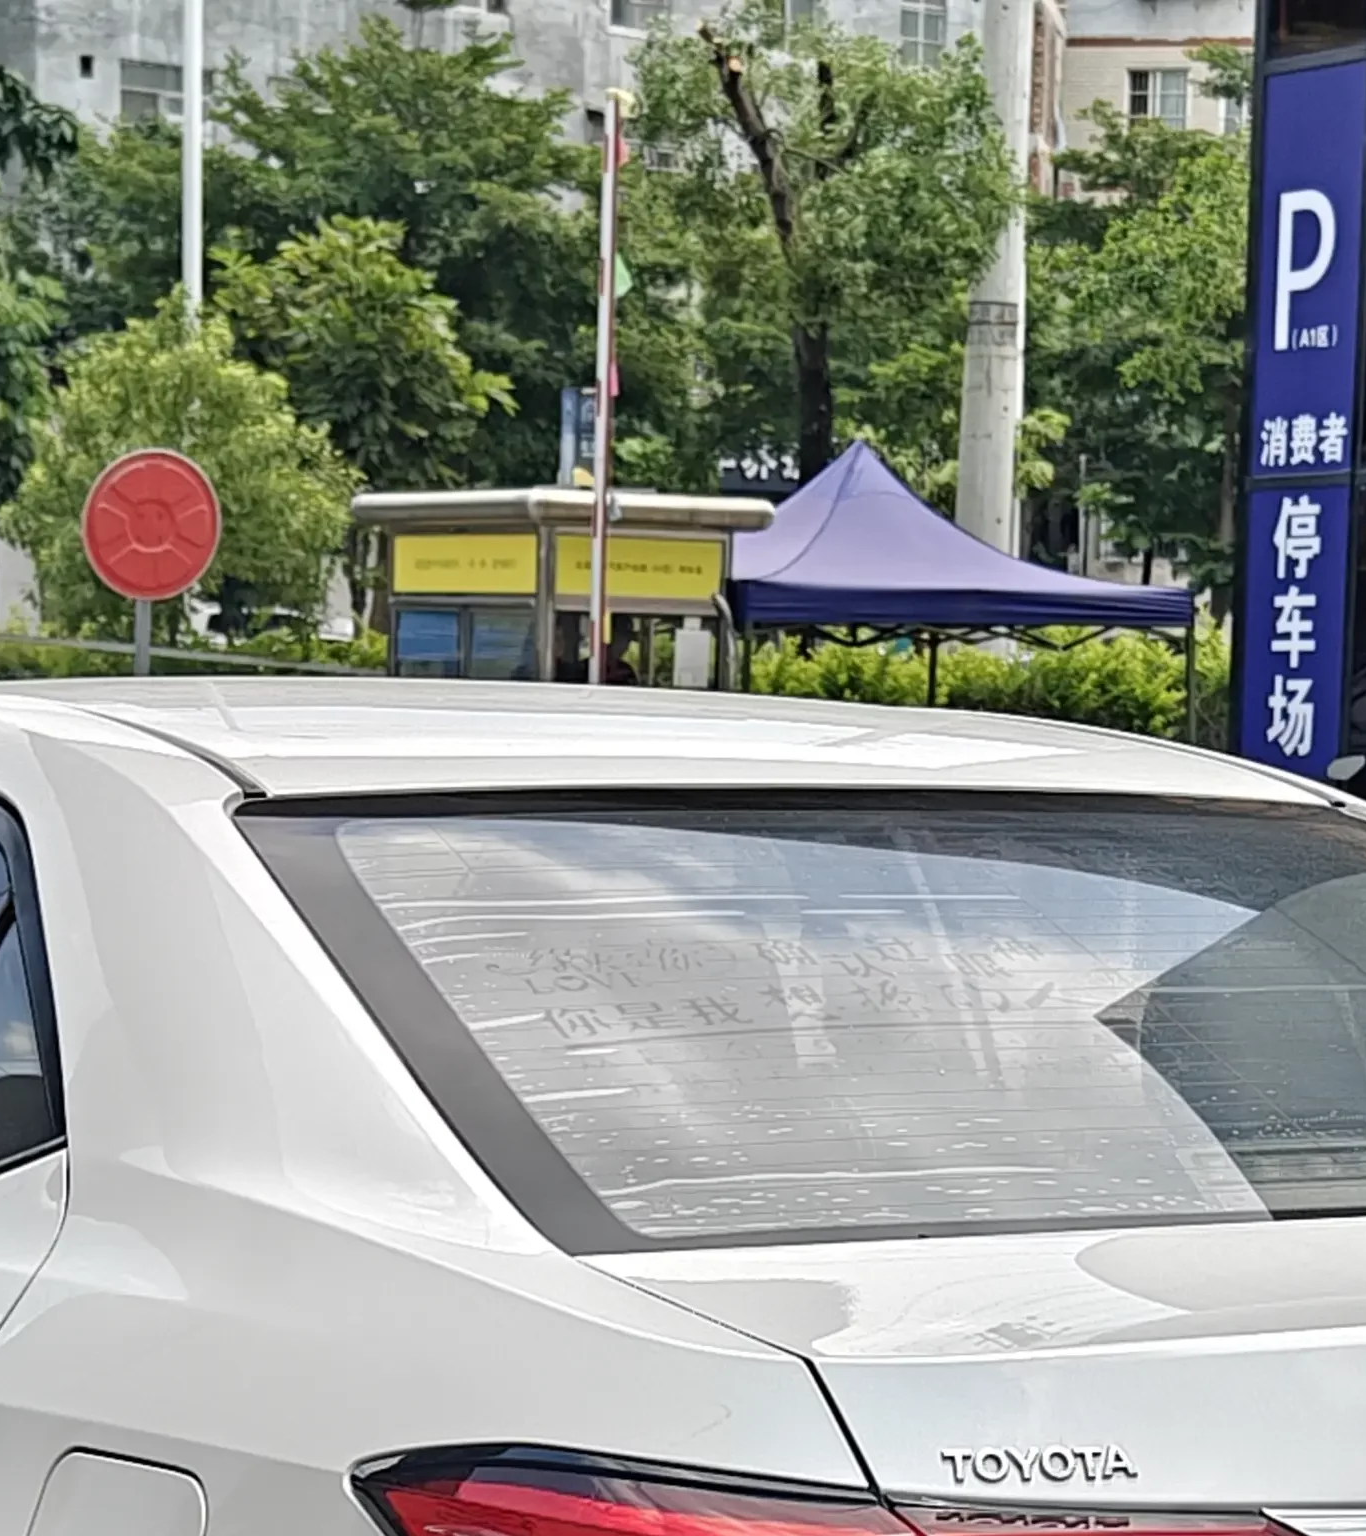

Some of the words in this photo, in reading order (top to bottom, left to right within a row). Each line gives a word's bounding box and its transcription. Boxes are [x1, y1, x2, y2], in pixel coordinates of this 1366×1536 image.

[1274, 188, 1337, 351] P
[1259, 412, 1349, 468] 消费者
[1266, 495, 1322, 757] 停车场
[939, 1444, 1139, 1485] TOYOTA
